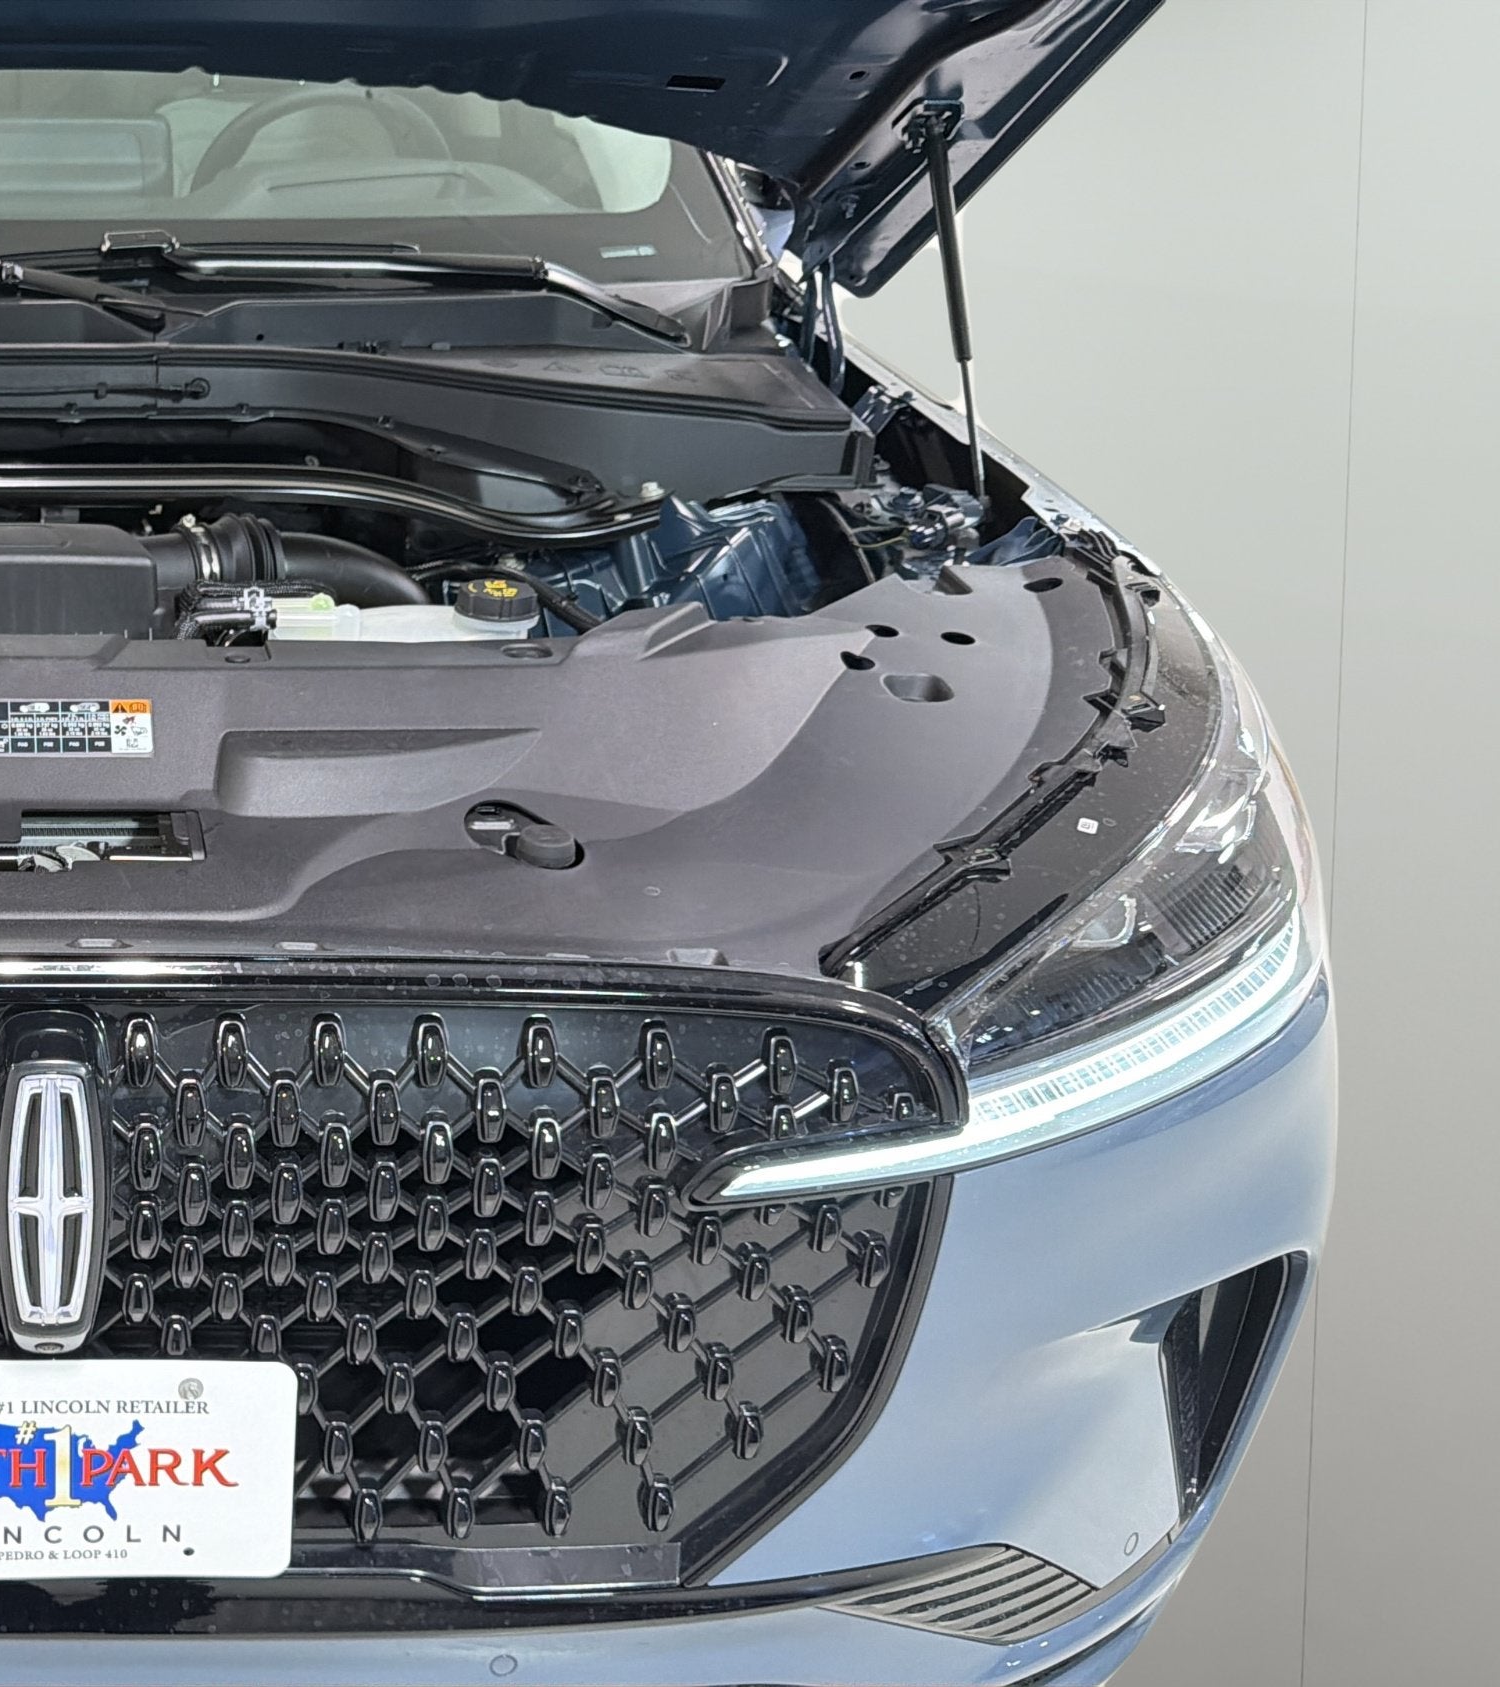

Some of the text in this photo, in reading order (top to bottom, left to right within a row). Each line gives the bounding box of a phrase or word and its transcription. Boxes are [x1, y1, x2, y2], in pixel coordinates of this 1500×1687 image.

[21, 1399, 110, 1415] LINCOLN
[116, 1399, 210, 1414] RETAILER
[81, 1448, 239, 1488] PARK
[48, 1549, 59, 1560] &
[63, 1549, 102, 1560] LOOP
[105, 1549, 128, 1559] 410
